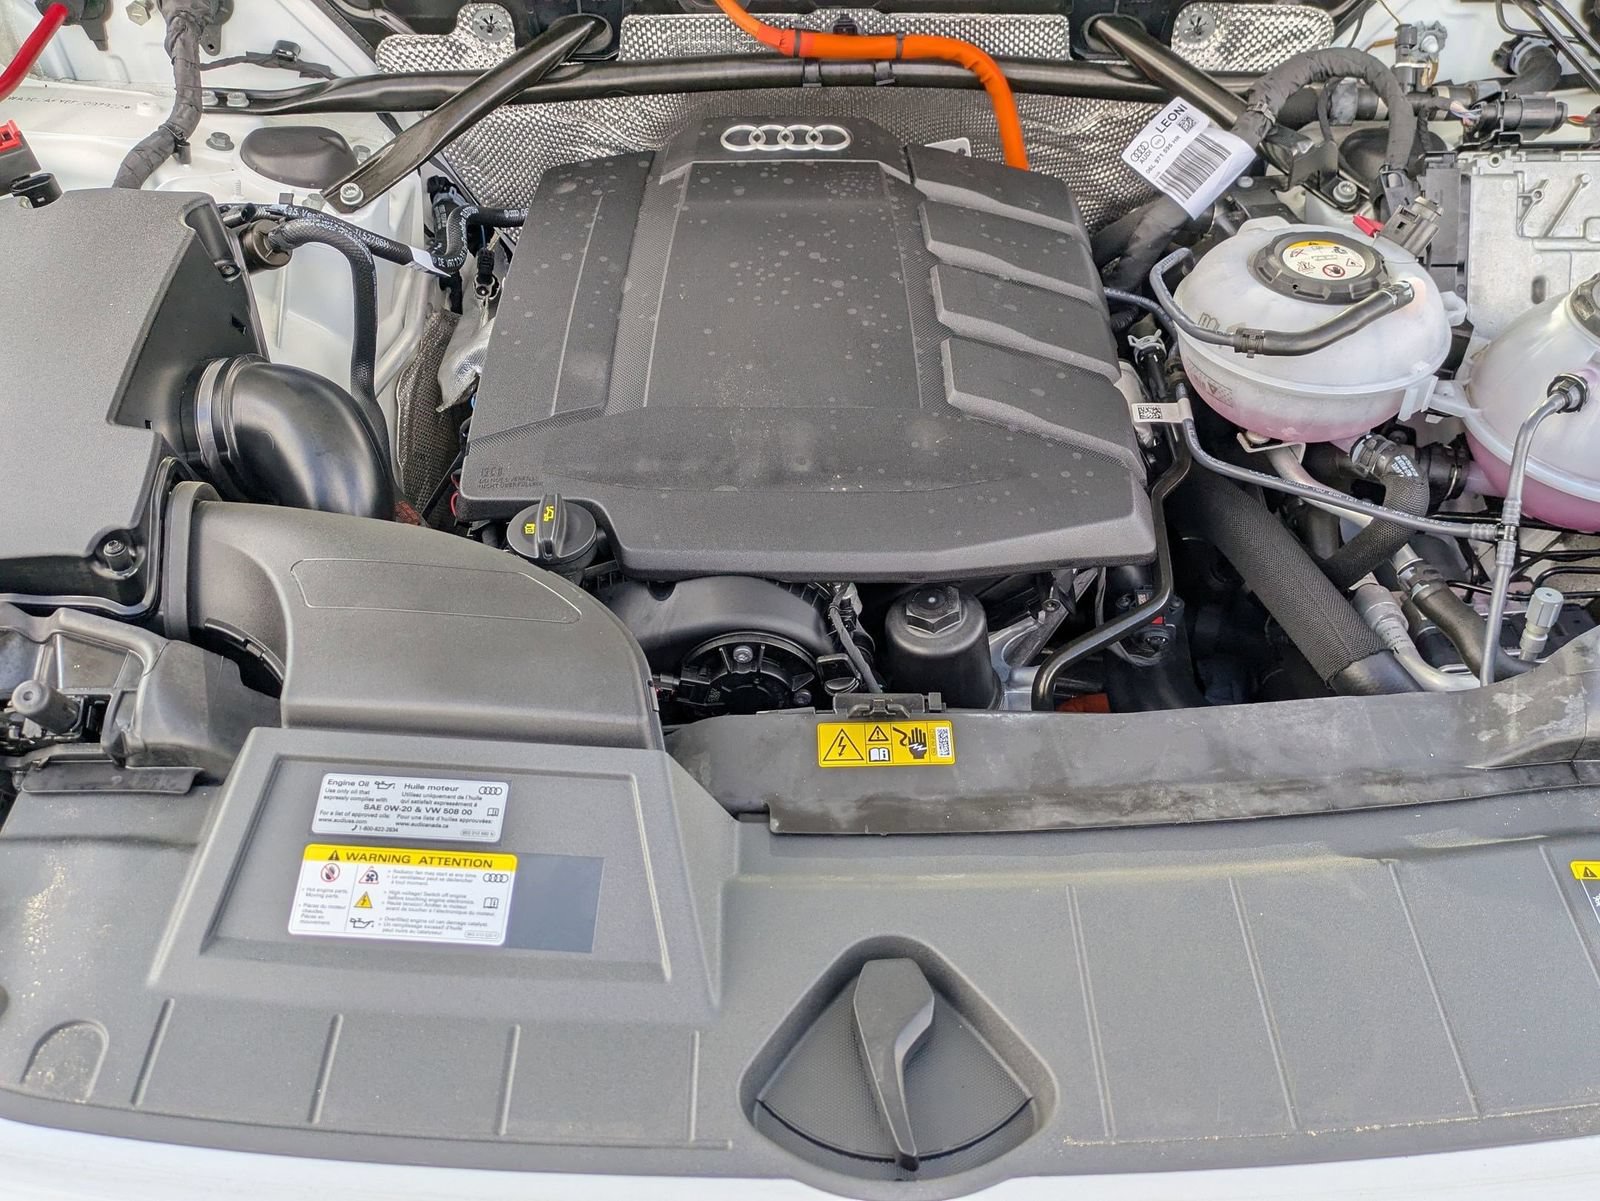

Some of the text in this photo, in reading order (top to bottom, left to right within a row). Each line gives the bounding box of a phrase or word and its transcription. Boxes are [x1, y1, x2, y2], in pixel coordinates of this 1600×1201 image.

[1156, 104, 1188, 133] LEONI
[1139, 150, 1152, 164] AUDI
[346, 852, 493, 868] WARNING ATTENTION
